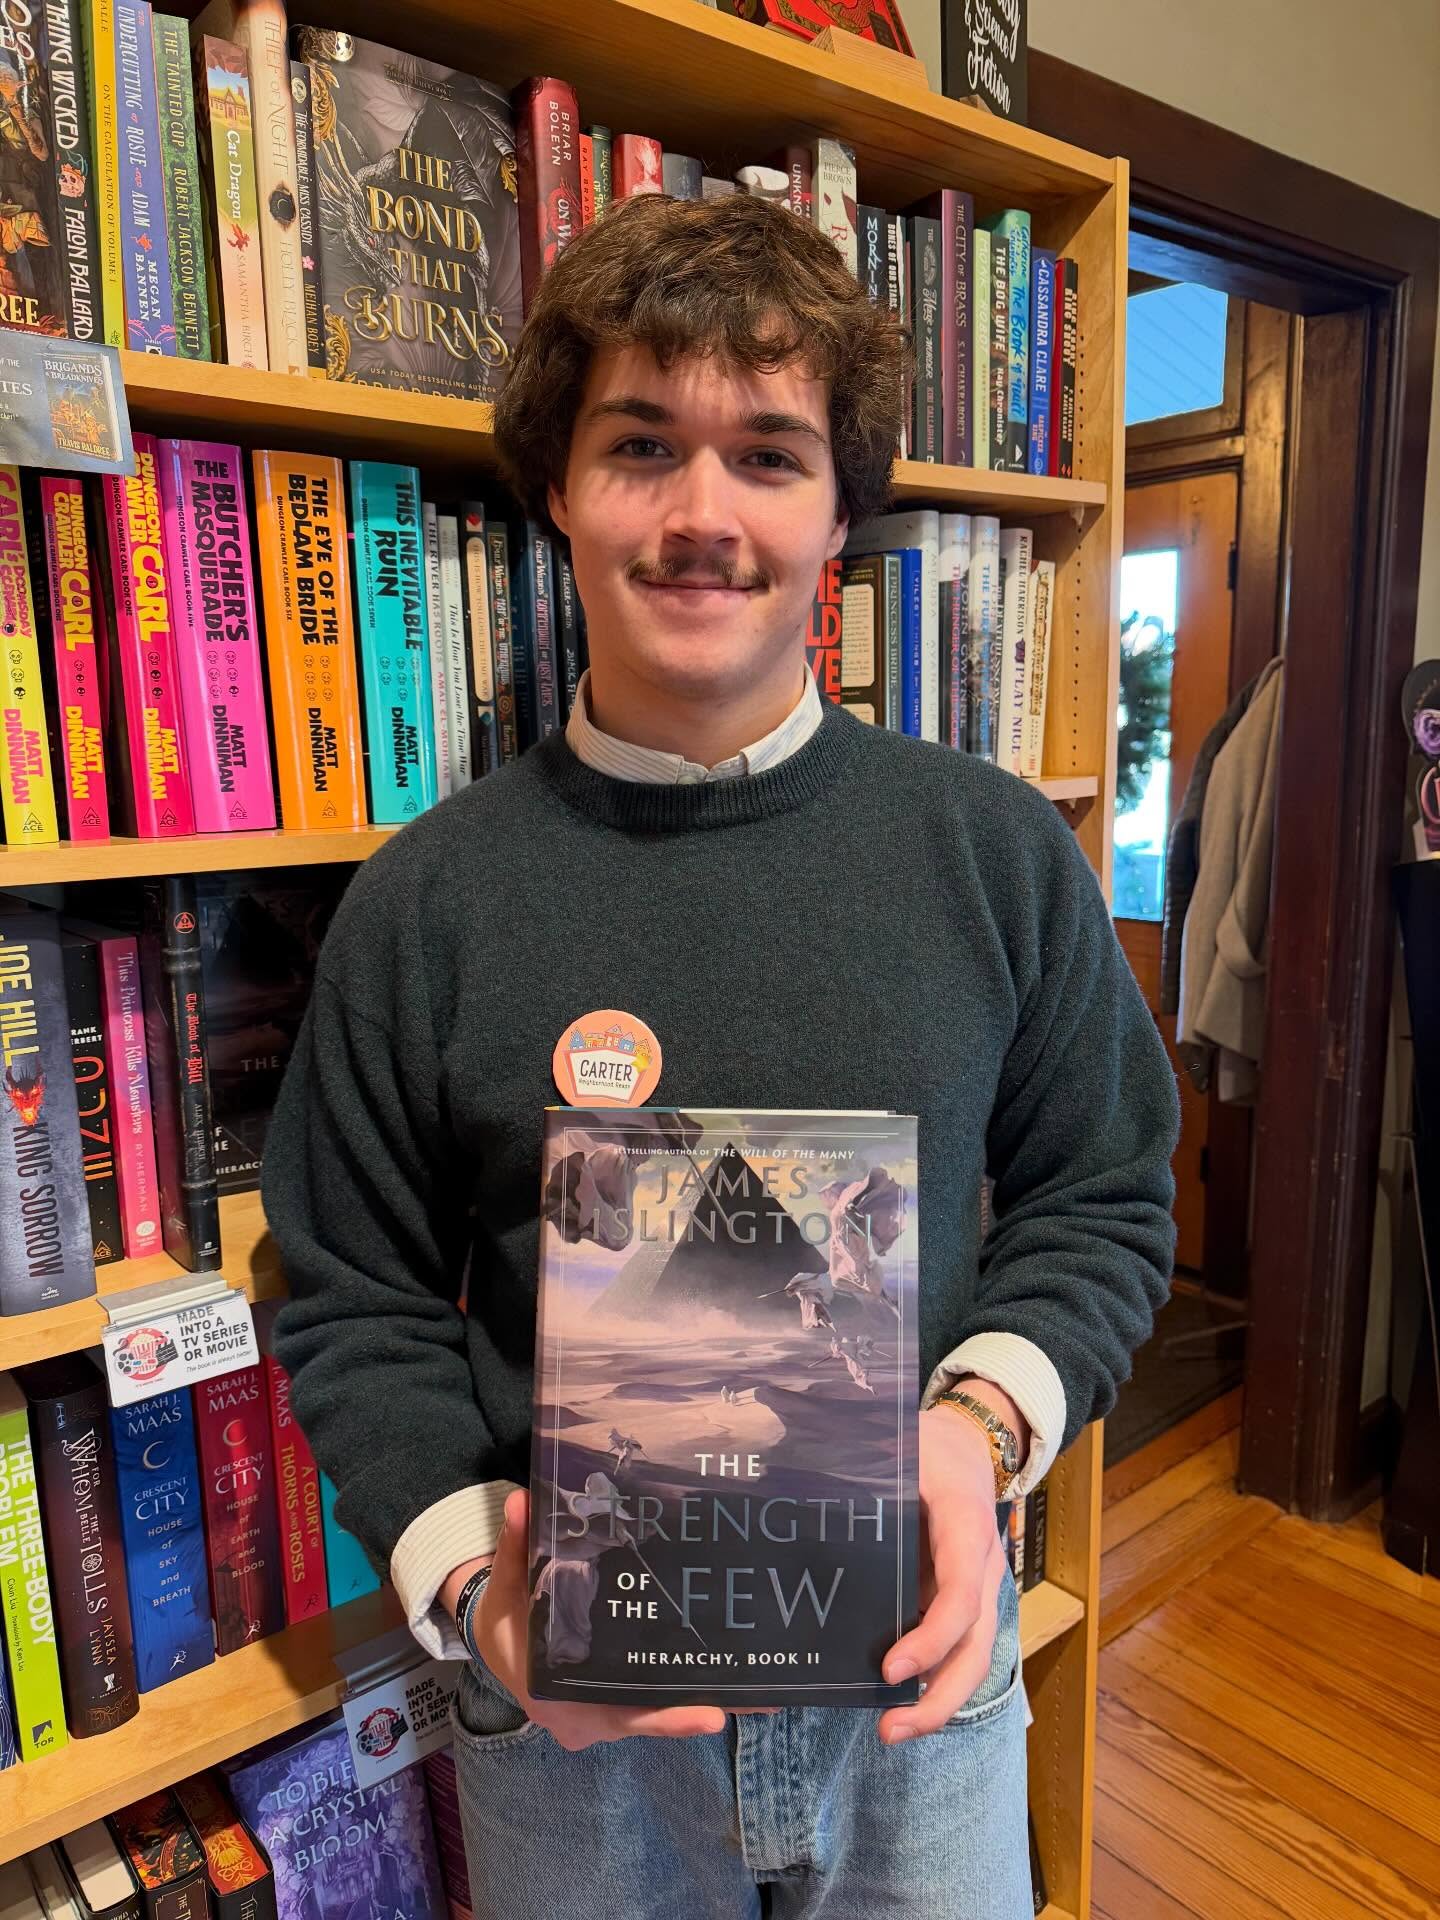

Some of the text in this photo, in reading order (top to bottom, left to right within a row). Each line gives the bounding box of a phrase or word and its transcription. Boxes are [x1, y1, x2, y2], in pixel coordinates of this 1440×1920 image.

[968, 30, 1010, 114] Fiction
[51, 70, 79, 150] WICKED
[549, 101, 561, 166] BOLEYN
[561, 112, 571, 161] BRIAR
[164, 31, 200, 350] THE TAINTED CUP ROBERT JACKSON BENNETT
[226, 130, 243, 219] Cat Dragon
[399, 148, 453, 192] THE
[823, 171, 852, 185] BROWN
[132, 190, 150, 227] ADAM
[367, 186, 482, 253] BOND
[64, 207, 93, 341] FALON BALLARD
[135, 253, 149, 321] BANNEN
[147, 260, 161, 319] MEGAN
[388, 247, 465, 294] THAT
[236, 254, 253, 358] SAMANTHA BIRCH
[344, 285, 514, 366] BURNS
[1035, 269, 1049, 393] CASSANDRA CLARE
[43, 359, 103, 378] BRIGANDS
[995, 247, 1005, 446] THE BOG WIFE Kay Chronister
[370, 367, 386, 376] USA
[390, 370, 414, 379] TODAY
[417, 374, 466, 389] BESTSELLING
[469, 384, 497, 394] AUTHOR
[59, 437, 111, 457] TRAVIS BALDREE
[194, 459, 229, 478] THE
[140, 452, 162, 545] DUNGEON
[277, 495, 286, 531] DUNGEON
[54, 491, 75, 569] CRAWLER
[69, 493, 88, 570] DUNGEON
[280, 532, 288, 566] CRAWLER
[191, 480, 224, 642] MASQUERADE
[213, 482, 249, 641] BUTCHER'S
[288, 473, 321, 646] BEDLAM BRIDE
[311, 477, 338, 646] THE EYE OF THE
[371, 529, 399, 597] RUIN
[395, 480, 424, 652] THIS INEVITABLE
[1017, 535, 1028, 635] RACHEL HARRISON
[61, 570, 95, 652] CARL
[132, 545, 171, 643] CARL
[890, 576, 899, 645] PRINCESS
[428, 521, 449, 779] THE RIVER HAS ROOTS AMAL EL-MOHTAR
[951, 596, 961, 653] HUNGER
[890, 649, 899, 689] BRIDE
[951, 656, 960, 674] OF
[960, 582, 969, 729] JOHN GWYNNE
[449, 604, 468, 776] This Is How You Lose the Time War
[950, 680, 959, 704] THE
[24, 728, 45, 778] MATT
[212, 705, 235, 793] DINNIMAN
[230, 724, 246, 768] MATT
[308, 707, 328, 792] DINNIMAN
[324, 726, 339, 768] MATT
[950, 709, 959, 748] GODS
[4, 708, 31, 805] DINNIMAN
[0, 934, 39, 1068] JOE HILL
[580, 1059, 633, 1082] CARTER
[13, 1122, 54, 1178] KING
[613, 1147, 663, 1156] BESTSELLING
[664, 1147, 698, 1157] AUTHOR
[713, 1147, 736, 1158] THE
[740, 1148, 768, 1159] WILL
[772, 1149, 790, 1159] OF
[792, 1149, 816, 1160] THE
[819, 1149, 855, 1160] MANY
[136, 1144, 147, 1213] RY HERMAN
[656, 1164, 808, 1204] JAMES
[19, 1184, 65, 1278] SORROW
[591, 1208, 874, 1248] ISLINGTON
[176, 1306, 216, 1325] MADE
[180, 1316, 225, 1337] INTO A
[181, 1321, 250, 1350] TV SERIES
[183, 1335, 248, 1362] OR MOVIE
[127, 1407, 182, 1437] MAAS
[61, 1427, 102, 1513] WHOM
[91, 1466, 100, 1487] FOR
[134, 1476, 187, 1502] CRESCENT
[281, 1442, 299, 1510] THORNS
[694, 1453, 761, 1477] THE
[79, 1513, 91, 1543] BELLE
[90, 1513, 99, 1535] THE
[135, 1488, 190, 1520] CITY
[147, 1519, 183, 1537] HOUSE
[567, 1496, 883, 1542] STRENGTH
[8, 1434, 57, 1645] THE THREE-BODY
[159, 1555, 178, 1569] SKY
[161, 1540, 173, 1550] of
[289, 1530, 306, 1584] ROSES
[80, 1536, 108, 1615] TOLLS
[152, 1586, 192, 1608] BREATH
[160, 1573, 180, 1585] and
[617, 1572, 651, 1592] OF
[681, 1567, 845, 1630] FEW
[607, 1599, 659, 1620] THE
[89, 1629, 103, 1666] LYNN
[101, 1616, 117, 1666] JAYSEA
[627, 1651, 820, 1667] HIERARCHY, BOOK II
[34, 1737, 55, 1749] TOR
[268, 1778, 403, 1849] A CRYSTAL
[294, 1811, 388, 1874] BLOOM
